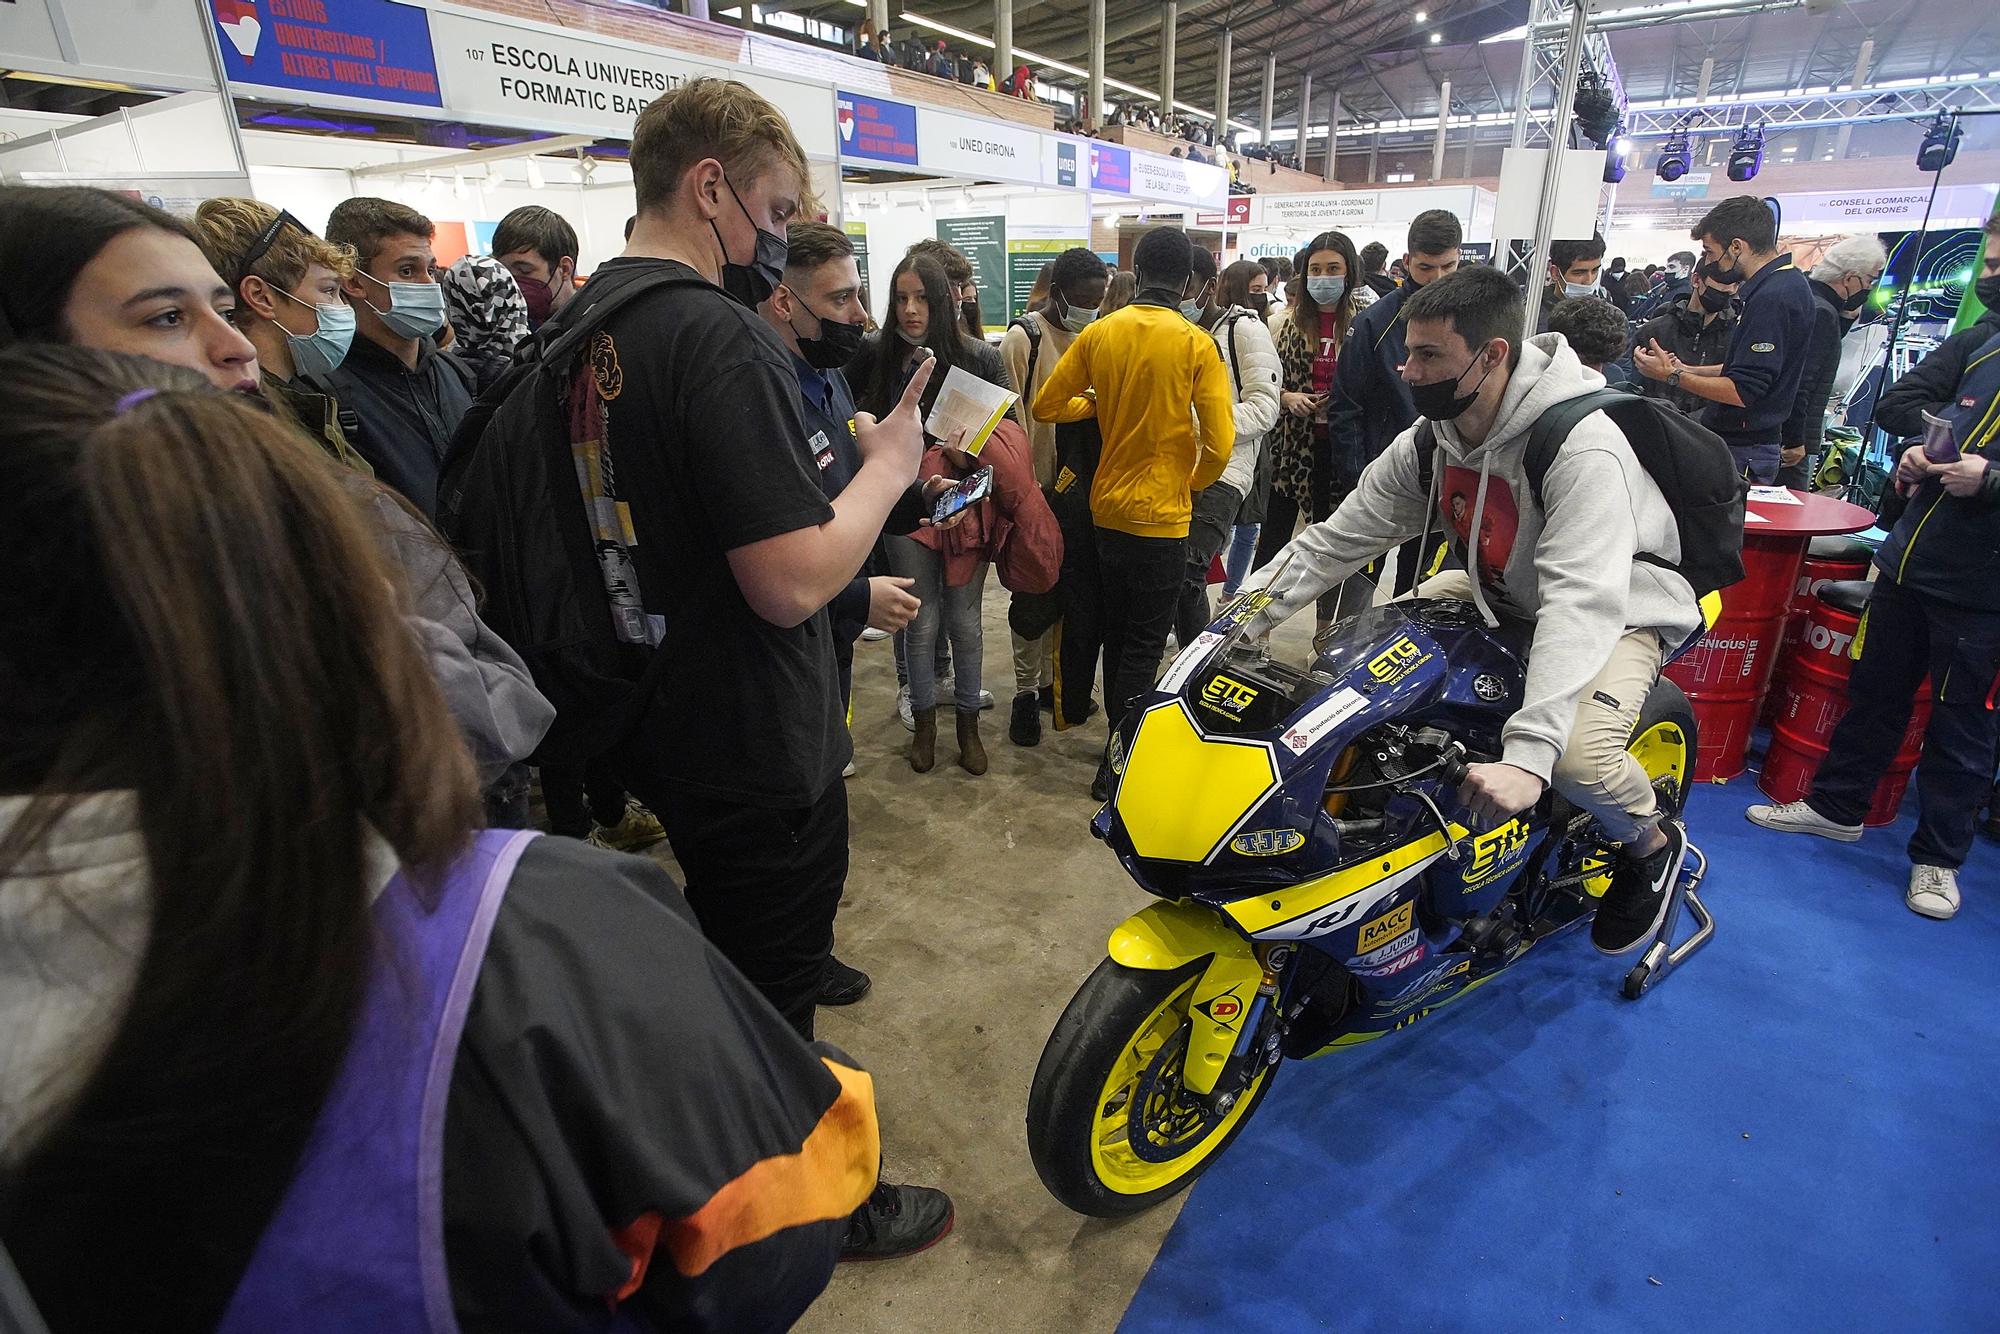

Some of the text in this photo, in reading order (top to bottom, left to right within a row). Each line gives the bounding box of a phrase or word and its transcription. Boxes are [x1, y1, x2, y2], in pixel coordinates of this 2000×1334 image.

[274, 23, 376, 59] UNIVERSITARIS
[281, 52, 436, 93] ALTRES NIVELL SUPERIOR
[466, 49, 484, 61] 107
[491, 43, 581, 77] ESCOLA
[500, 77, 606, 110] FORMATIC
[959, 137, 982, 153] UNED
[984, 141, 1016, 158] GIRONA
[1311, 199, 1337, 207] CATALUNYA
[1829, 198, 1872, 207] CONSELL
[1875, 195, 1931, 205] COMARCAL
[1250, 242, 1296, 258] oficina
[1367, 636, 1418, 677] ETG
[1697, 638, 1746, 649] ENIOUS
[1742, 640, 1758, 676] BLEND
[1400, 648, 1422, 669] Racing
[1208, 675, 1259, 707] ETG
[1221, 697, 1246, 712] Racing
[1309, 714, 1336, 734] Diputació
[1342, 697, 1362, 710] Girona
[1237, 829, 1295, 854] TJT
[1298, 900, 1360, 937] R1
[1364, 908, 1408, 942] RACC
[1393, 923, 1407, 933] Club
[1379, 932, 1415, 958] J.JUAN
